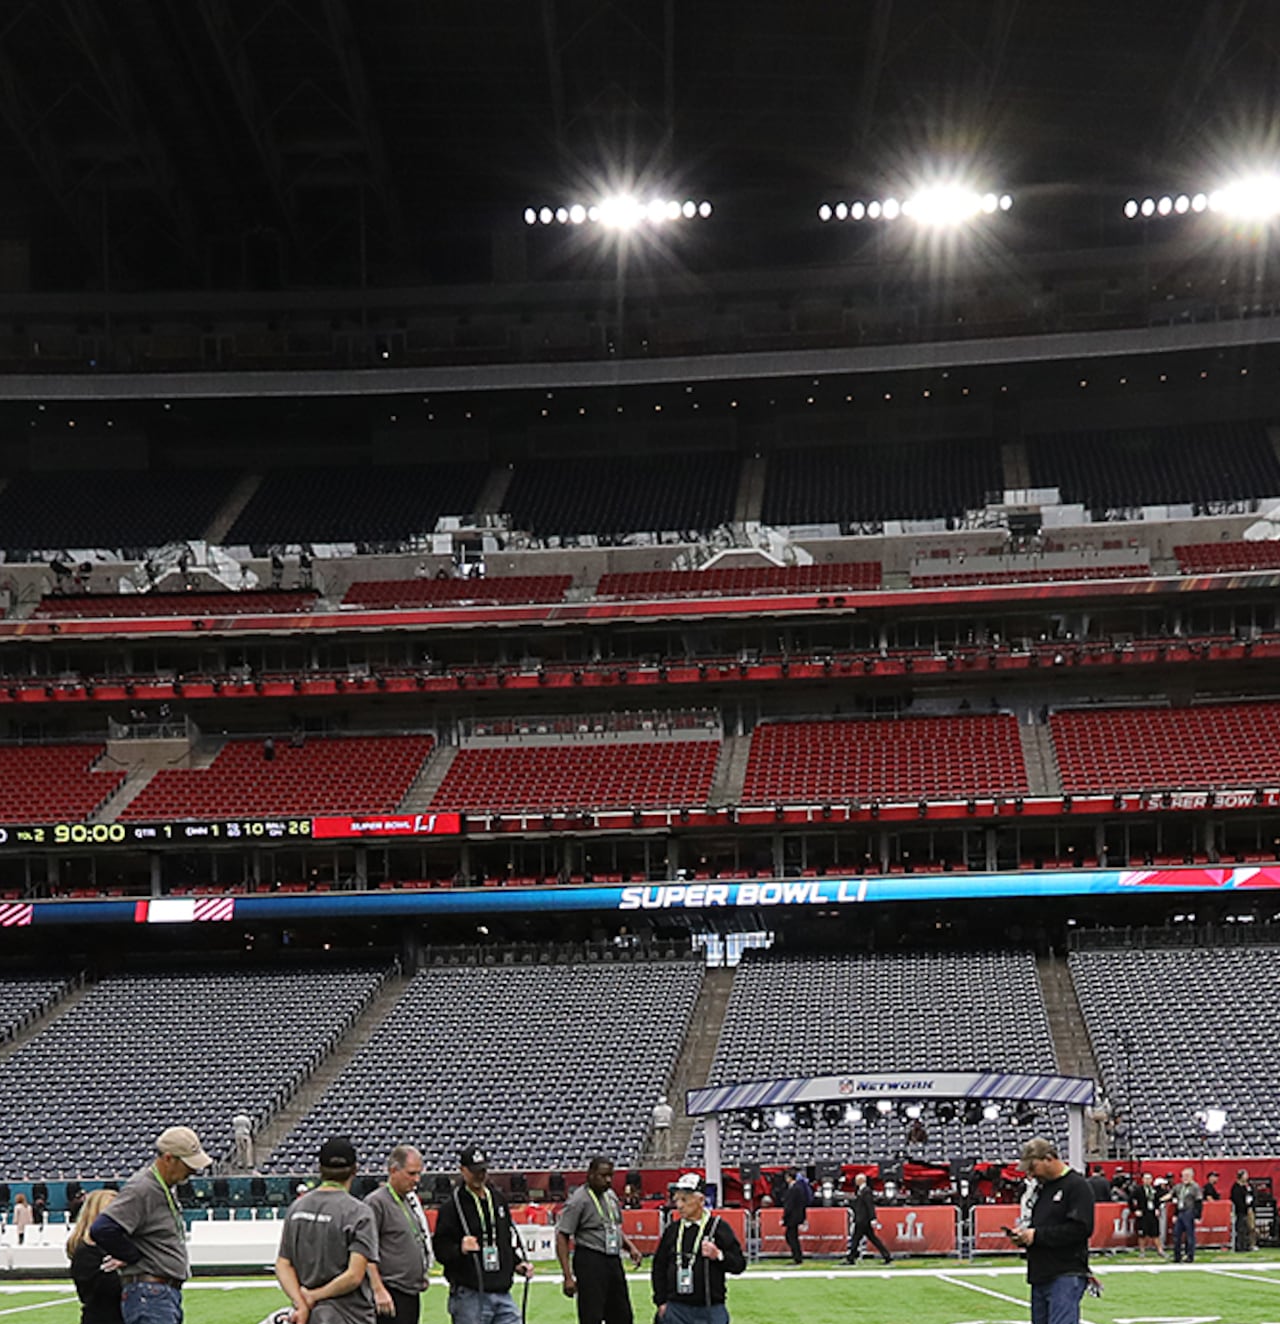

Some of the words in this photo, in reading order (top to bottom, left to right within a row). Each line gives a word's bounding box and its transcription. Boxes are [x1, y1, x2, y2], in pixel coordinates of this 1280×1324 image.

[163, 826, 172, 838] 1
[210, 824, 220, 837] 1
[243, 822, 264, 836] 10
[288, 820, 310, 835] 26
[351, 821, 384, 832] SUPER
[385, 820, 411, 831] BOWL
[33, 829, 45, 842] 2
[53, 824, 126, 843] 90:00
[618, 884, 730, 910] SUPER
[736, 881, 829, 906] BOWL
[837, 879, 869, 903] LI
